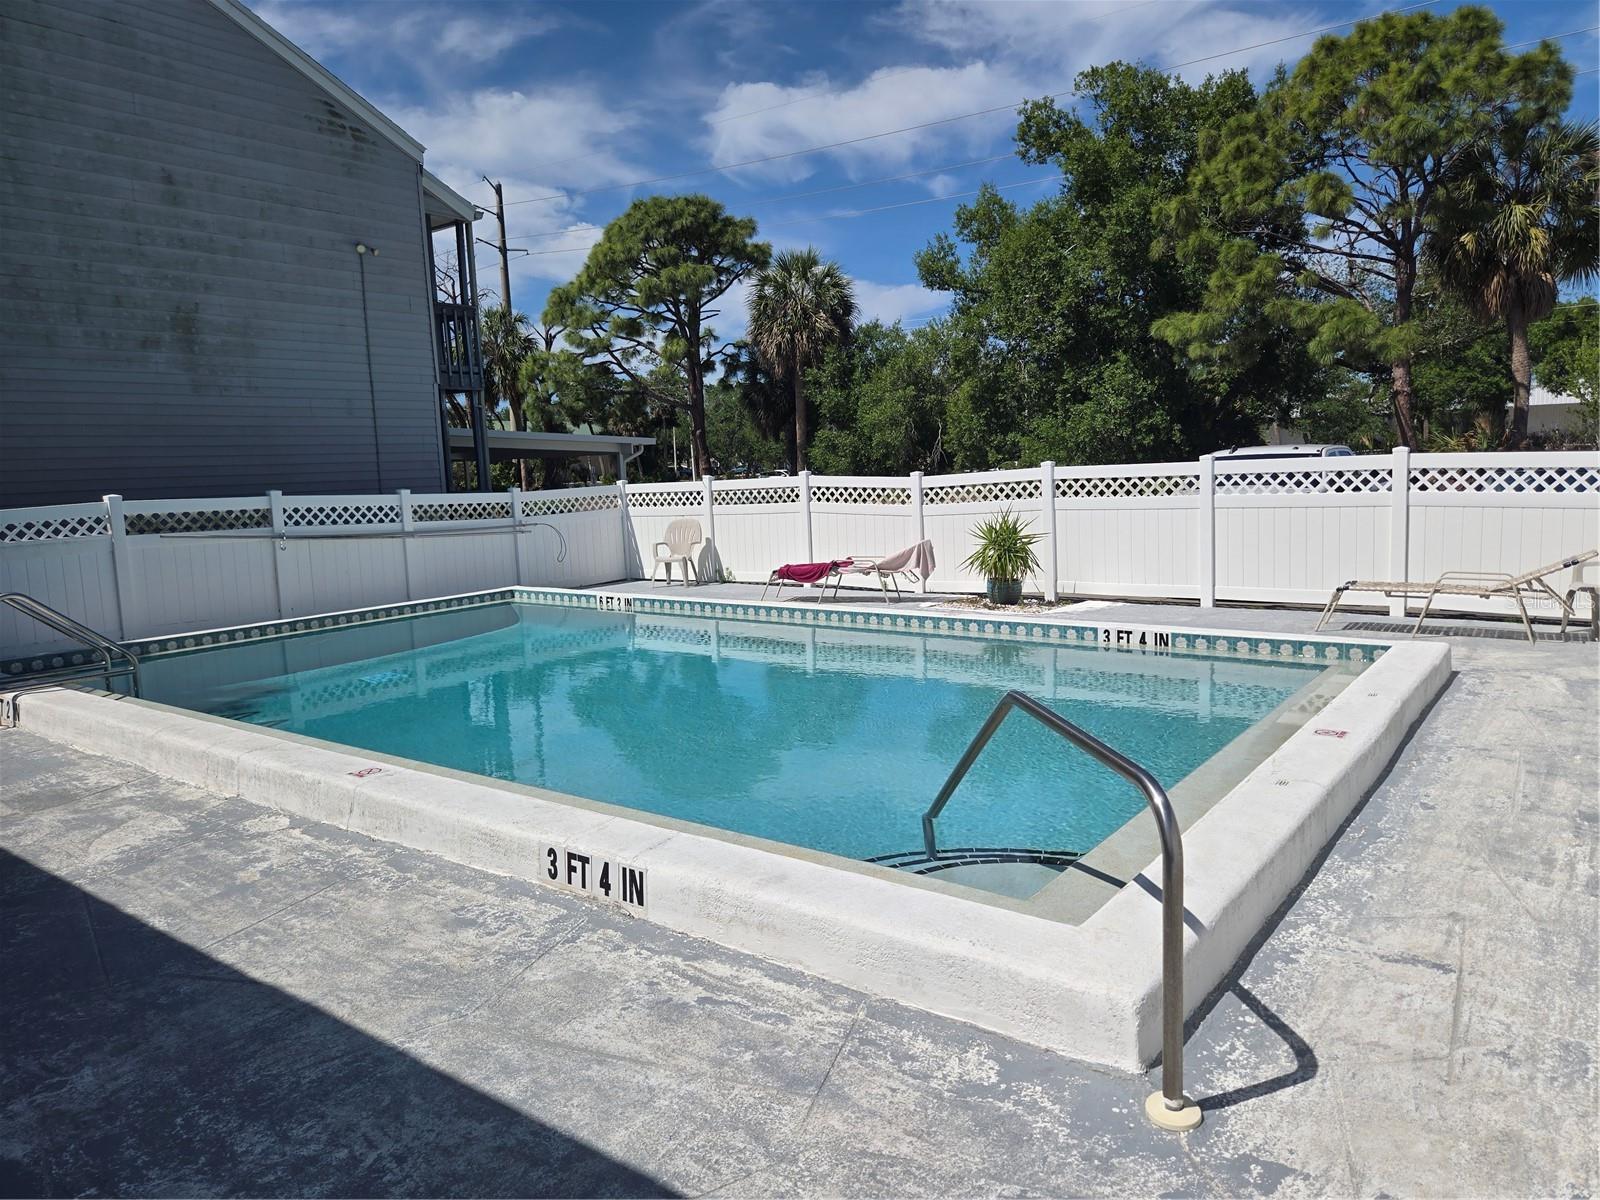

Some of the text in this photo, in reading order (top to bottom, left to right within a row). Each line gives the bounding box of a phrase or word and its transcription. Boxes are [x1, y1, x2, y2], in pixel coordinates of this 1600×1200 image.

[606, 596, 614, 606] FT
[624, 597, 632, 607] IN
[1103, 629, 1169, 648] 3 FT 4 IN
[547, 847, 644, 907] 3 FT 4 IN
